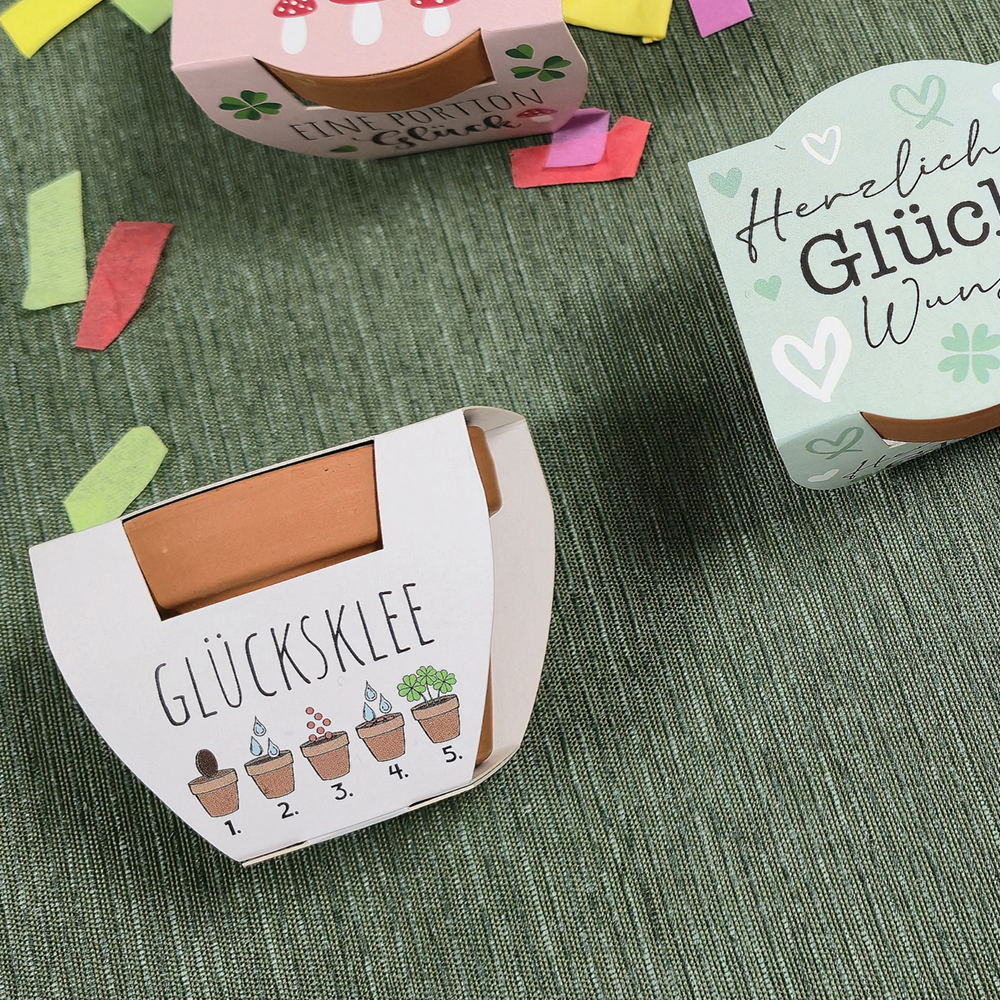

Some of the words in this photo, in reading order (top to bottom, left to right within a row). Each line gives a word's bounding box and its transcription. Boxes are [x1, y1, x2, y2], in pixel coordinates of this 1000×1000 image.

[289, 115, 383, 142] EINE
[387, 88, 545, 126] PORTION
[353, 114, 522, 149] Glück
[154, 582, 435, 727] GLÜCKSKLEE
[224, 819, 242, 837] 1.
[280, 801, 299, 819] 2.
[331, 782, 353, 801] 3.
[389, 764, 409, 780] 4.
[442, 744, 463, 764] 5.
